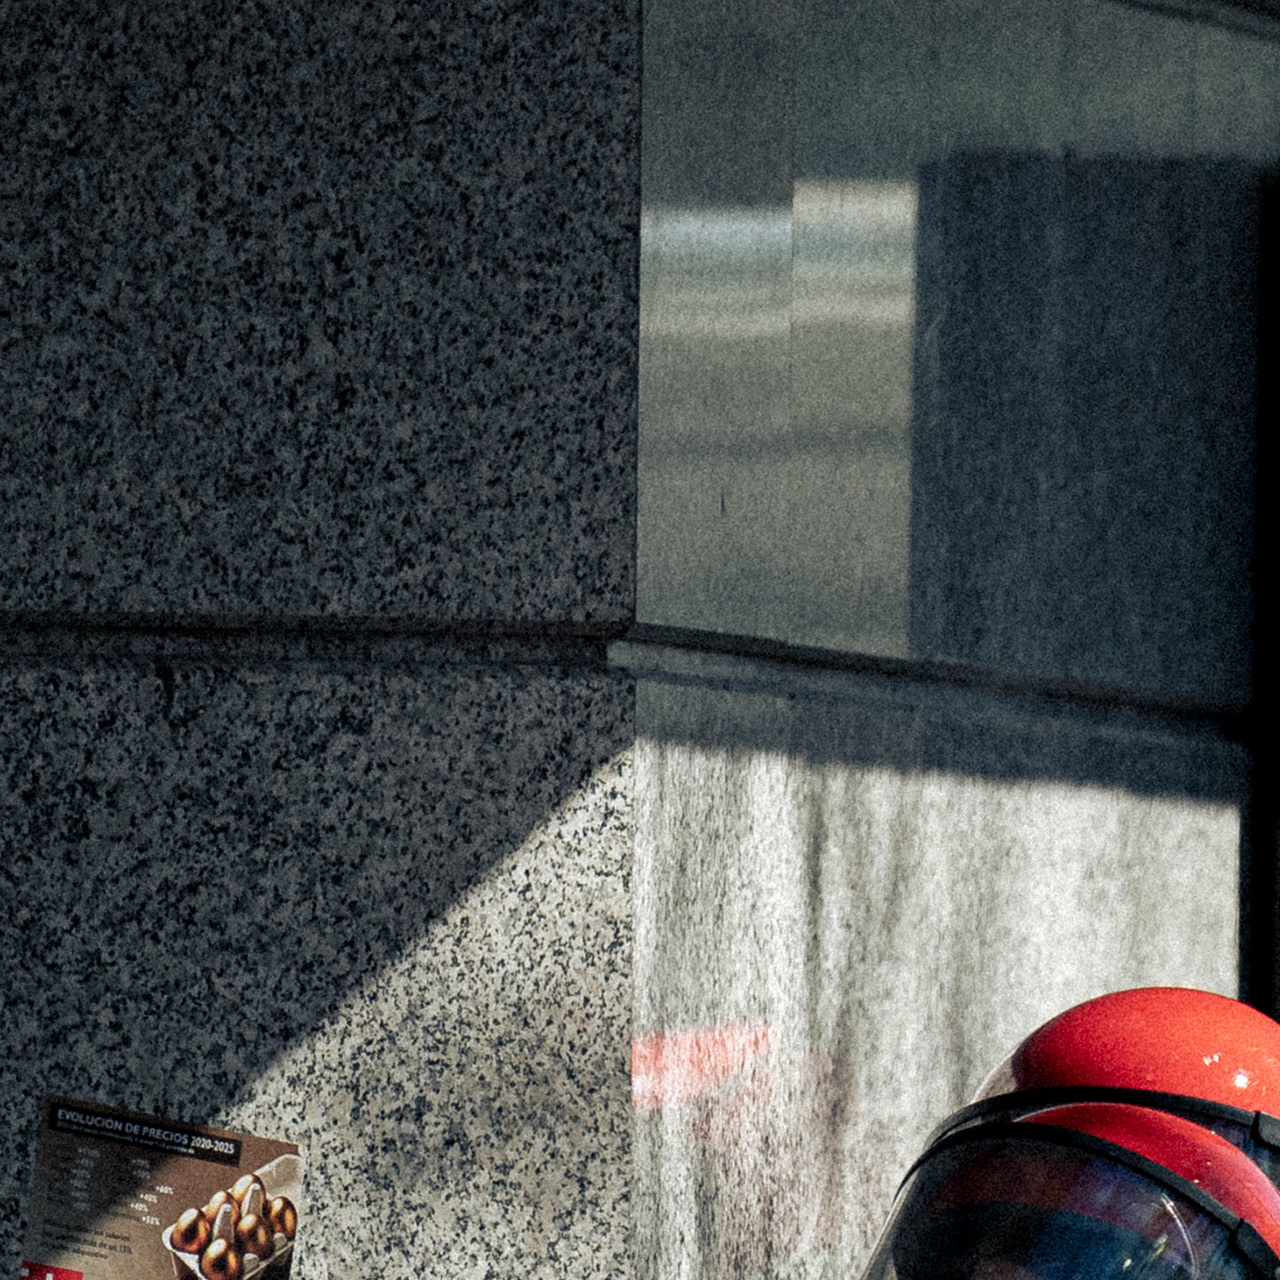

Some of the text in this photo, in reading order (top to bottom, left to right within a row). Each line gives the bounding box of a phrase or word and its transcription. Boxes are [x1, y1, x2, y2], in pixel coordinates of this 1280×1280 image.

[57, 1108, 123, 1132] EVOLUCIÓN
[124, 1121, 140, 1135] DE
[142, 1125, 189, 1145] PRECIOS
[190, 1136, 235, 1154] 2020-2025
